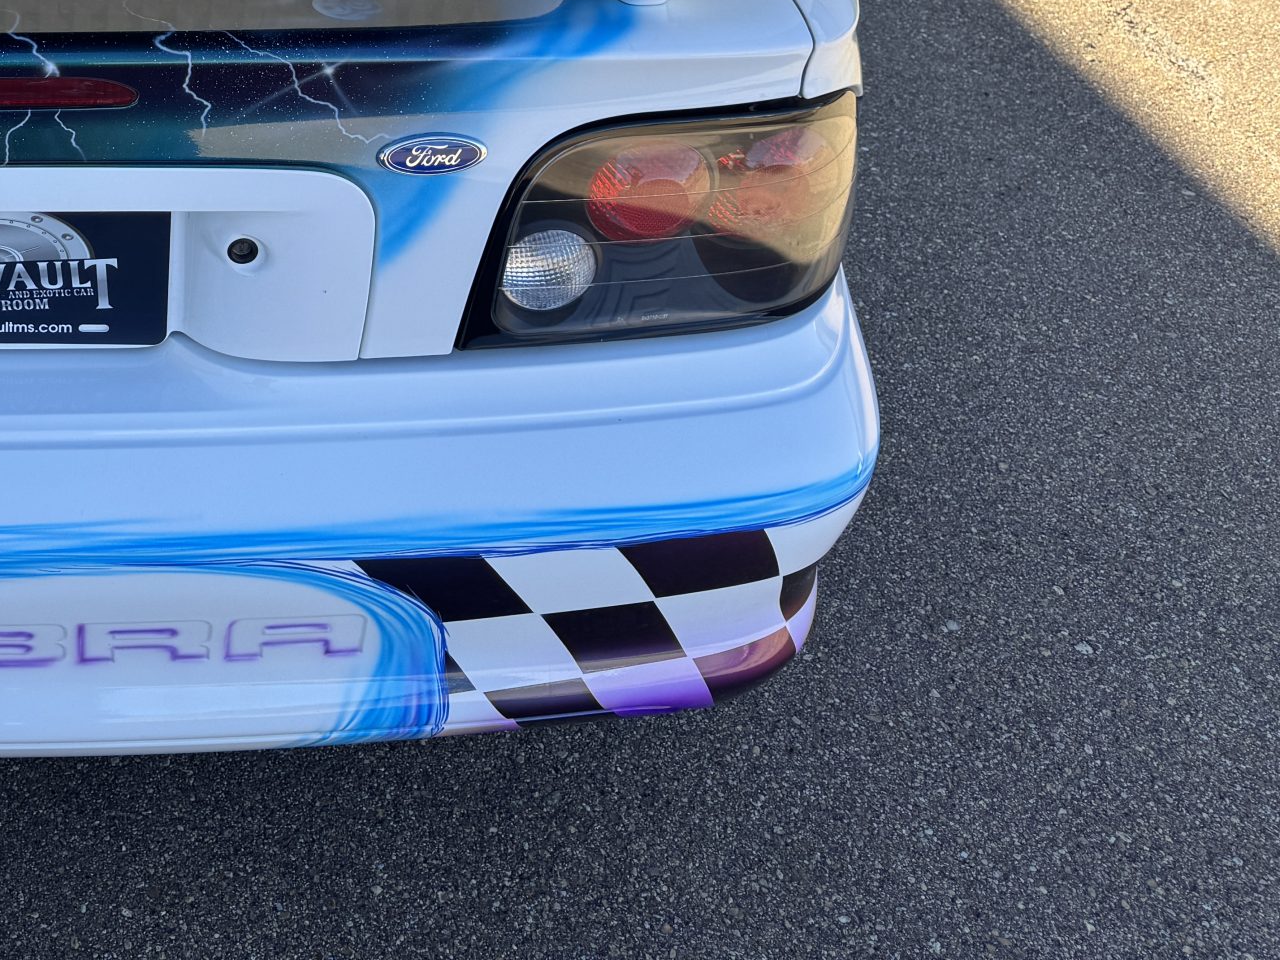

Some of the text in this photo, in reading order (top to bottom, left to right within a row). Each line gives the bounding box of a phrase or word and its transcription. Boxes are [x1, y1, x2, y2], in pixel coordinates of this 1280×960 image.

[405, 144, 462, 167] Ford
[8, 290, 31, 299] AND
[33, 289, 72, 298] EXOTIC
[73, 288, 95, 296] CAR
